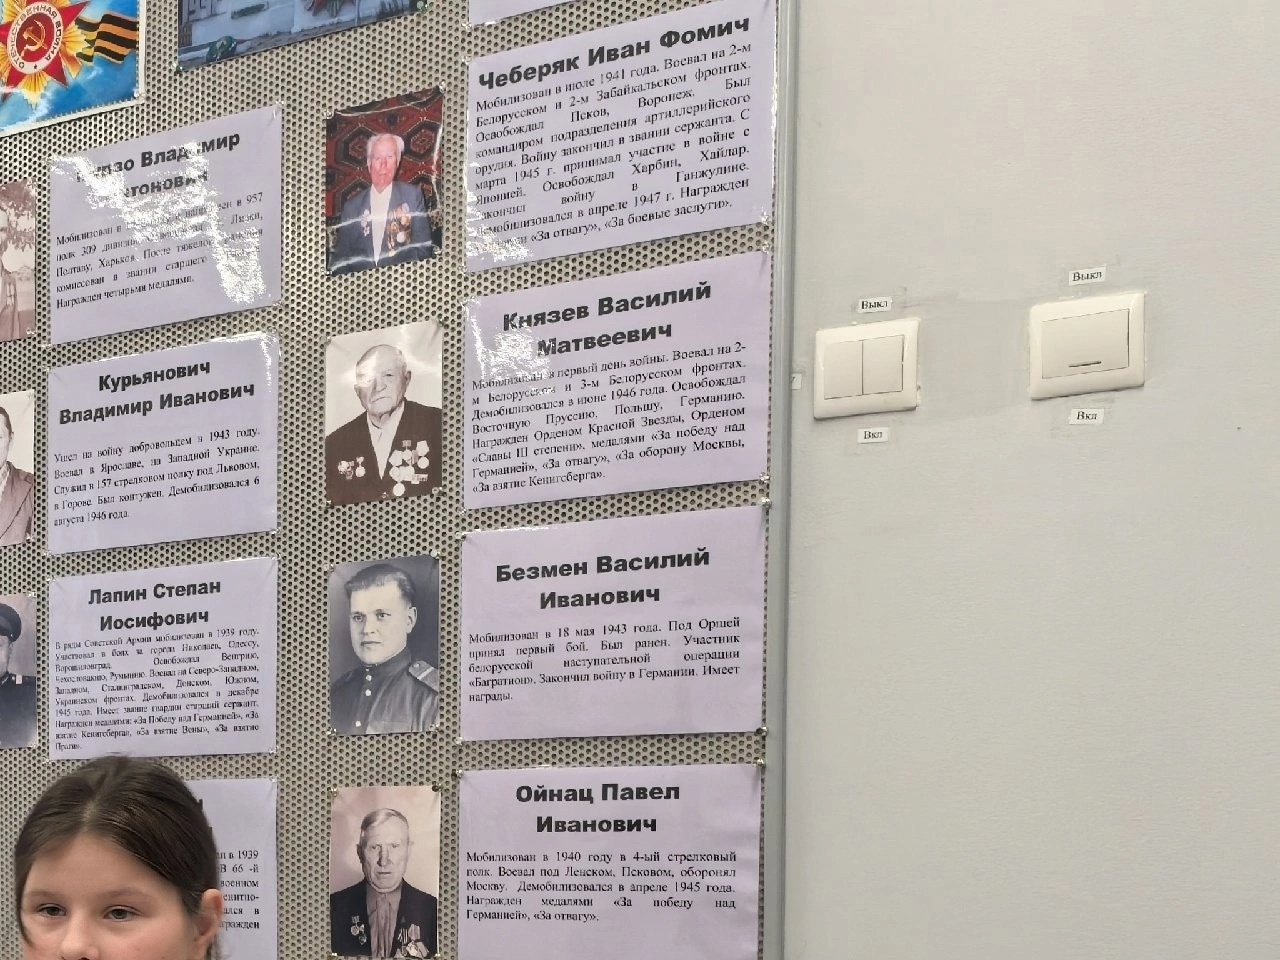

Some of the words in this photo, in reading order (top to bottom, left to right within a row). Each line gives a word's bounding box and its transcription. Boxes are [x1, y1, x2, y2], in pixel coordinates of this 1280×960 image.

[478, 55, 579, 89] Чеберяк
[587, 39, 650, 66] Иван
[659, 17, 749, 48] Фомич
[475, 121, 544, 142] Освобождал
[725, 76, 751, 89] Был
[476, 104, 546, 127] Белорусском
[569, 95, 588, 107] 2-м
[596, 74, 686, 101] Забайкальском
[475, 136, 543, 158] командиром
[550, 117, 636, 142] подразделения
[644, 94, 750, 124] артиллерийского
[1072, 271, 1102, 281] Выкл
[503, 305, 589, 331] Князев
[597, 280, 711, 316] Василий
[862, 300, 888, 309] Выкл
[537, 323, 671, 357] Матвеевич
[98, 361, 210, 393] Курьянович
[59, 400, 152, 424] Владимир
[159, 383, 254, 409] Иванович
[1077, 410, 1097, 420] Вкл
[472, 419, 530, 434] Восточную
[472, 435, 528, 449] Награжден
[533, 427, 582, 442] Орденом
[588, 417, 634, 435] Красной
[690, 406, 745, 422] Орденом
[863, 430, 882, 439] Вкл
[496, 561, 587, 582] Безмен
[596, 546, 709, 574] Василий
[87, 588, 147, 604] Лапин
[153, 581, 221, 599] Степан
[539, 588, 660, 609] Иванович
[100, 610, 208, 631] Иосифович
[468, 659, 532, 674] белорусской
[563, 652, 650, 669] наступательной
[683, 650, 739, 662] операции
[538, 673, 589, 683] Закончил
[593, 670, 626, 682] войну
[701, 664, 740, 675] Имеет
[515, 784, 594, 804] Ойнац
[601, 783, 679, 801] Павел
[536, 815, 656, 832] Иванович
[238, 850, 259, 860] 1939
[466, 851, 535, 861] Мобилизован
[556, 851, 581, 861] 1940
[588, 853, 612, 864] году
[632, 851, 659, 861] 4-ый
[667, 850, 736, 864] стрелковый
[232, 864, 243, 873] 66
